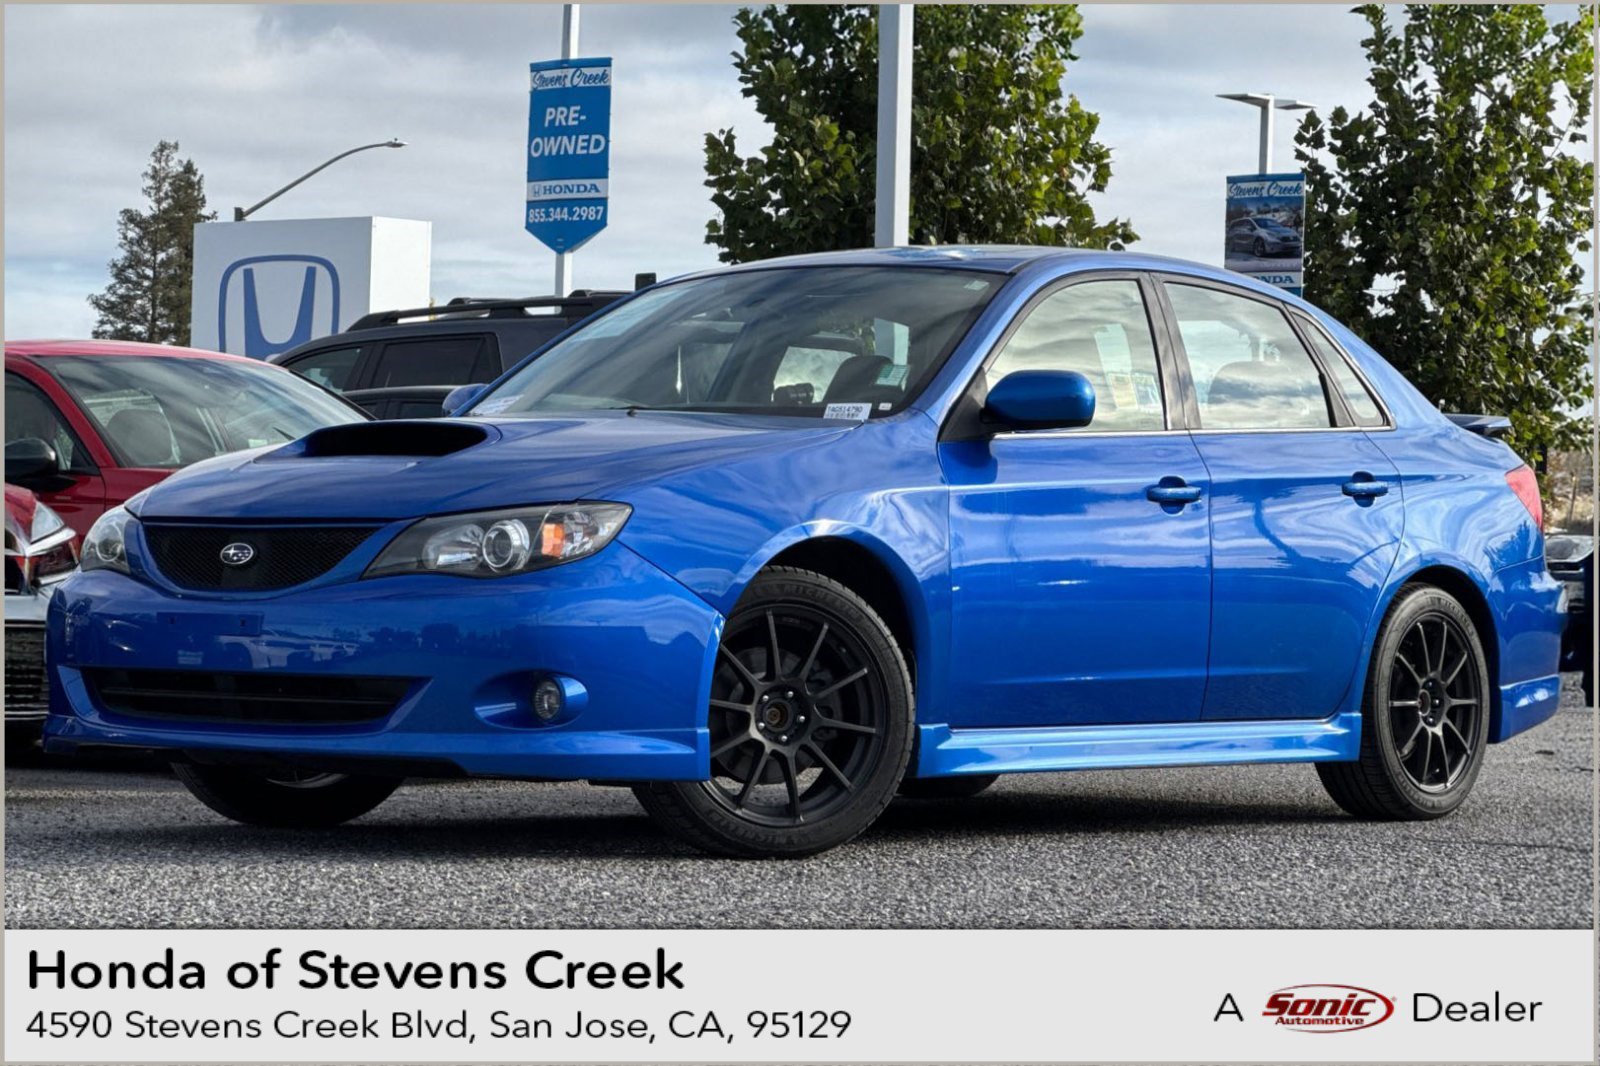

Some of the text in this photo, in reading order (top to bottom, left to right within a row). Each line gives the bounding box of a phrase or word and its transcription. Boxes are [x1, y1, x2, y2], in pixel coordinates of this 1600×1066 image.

[531, 67, 609, 89] Stevens Creek
[544, 105, 587, 128] PRE-
[530, 133, 606, 158] OWNED
[542, 182, 601, 196] HONDA
[1229, 180, 1302, 197] Stevens Creek
[528, 205, 604, 223] 855.344.2987
[1254, 275, 1295, 284] NDA
